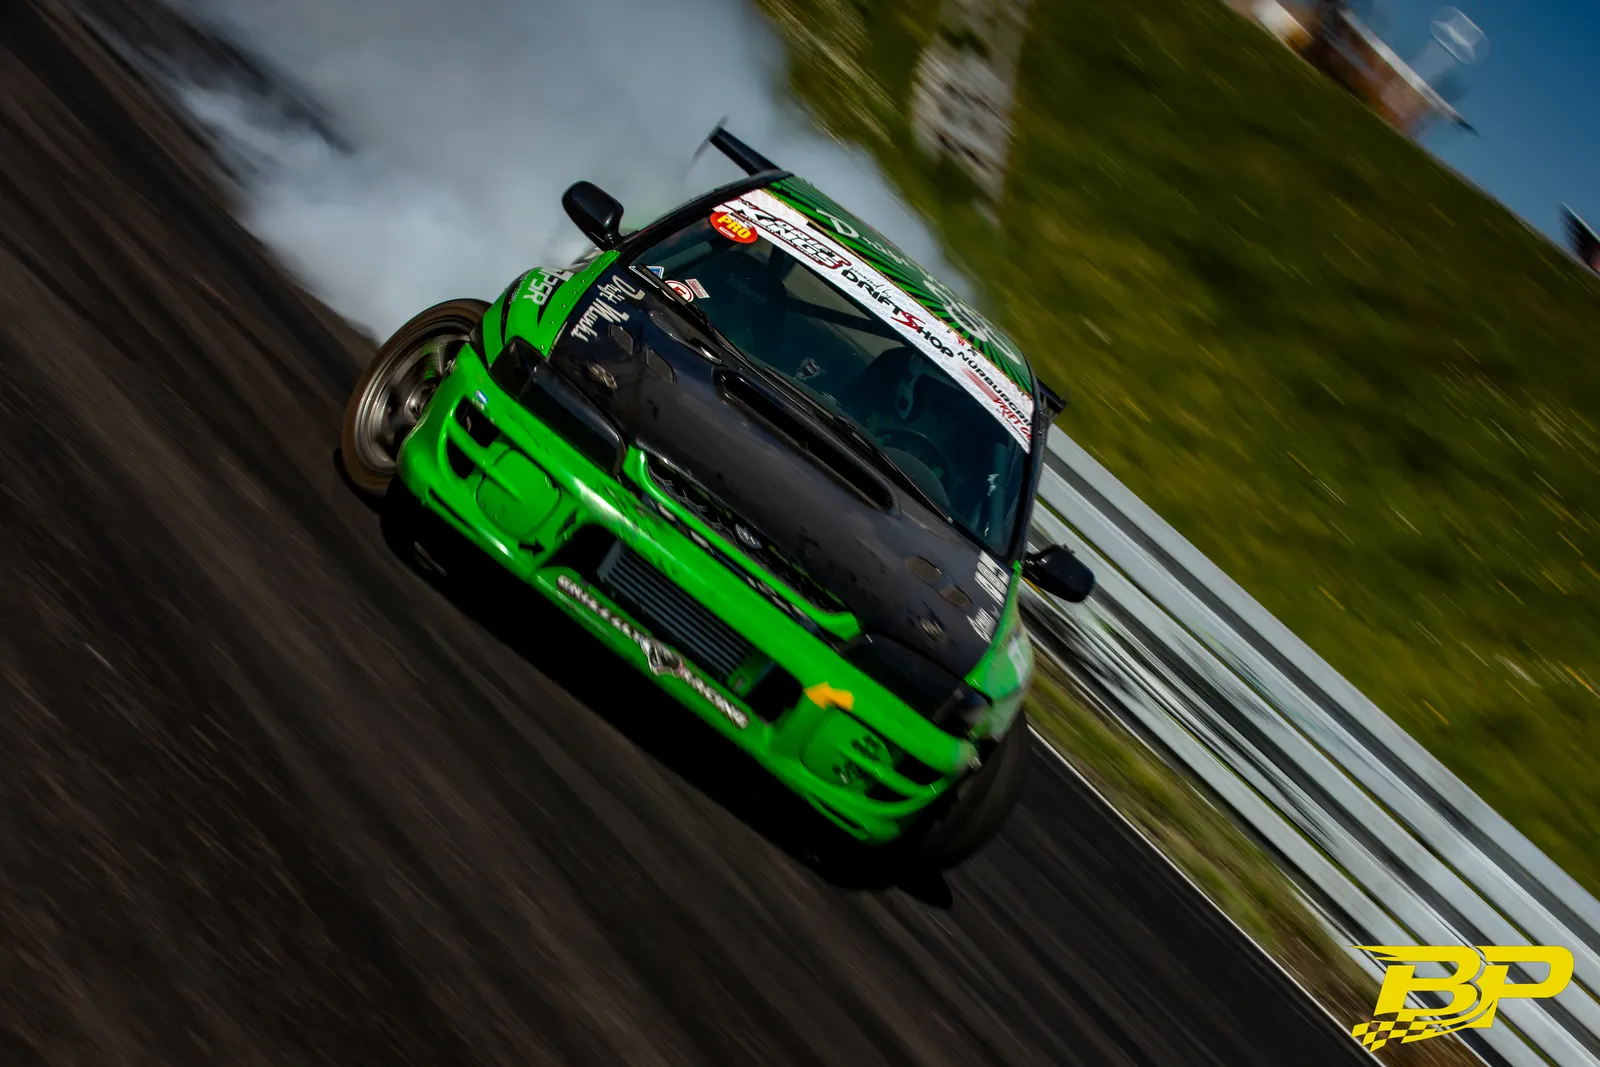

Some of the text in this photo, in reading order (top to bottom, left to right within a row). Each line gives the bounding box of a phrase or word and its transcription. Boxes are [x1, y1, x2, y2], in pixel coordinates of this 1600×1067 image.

[717, 215, 752, 239] PRO
[774, 220, 849, 265] DRIFT
[571, 275, 645, 342] Drift Munks
[841, 269, 954, 357] DRIFTSHOP
